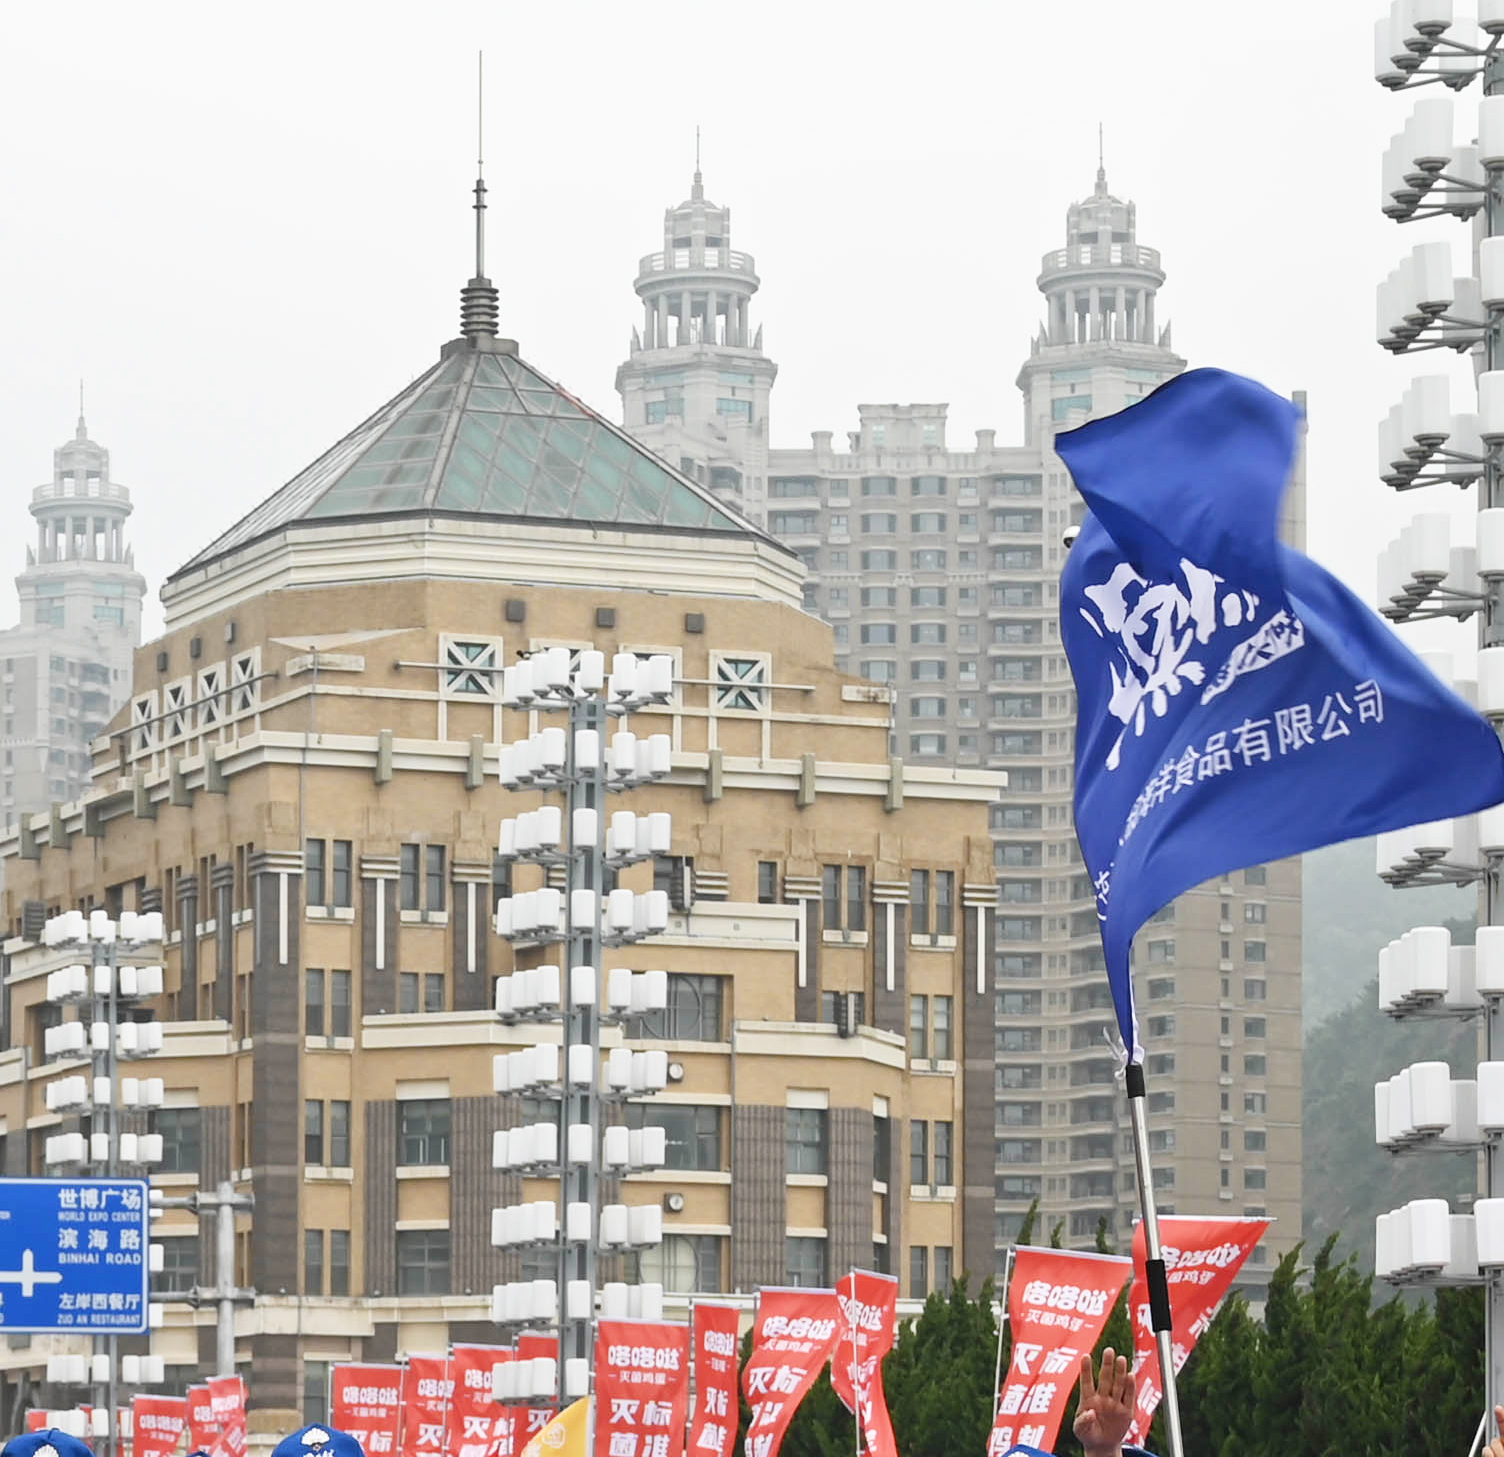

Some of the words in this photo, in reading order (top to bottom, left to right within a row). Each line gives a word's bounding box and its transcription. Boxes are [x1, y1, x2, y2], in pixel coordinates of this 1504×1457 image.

[58, 1188, 141, 1210] 世博广场
[58, 1228, 141, 1250] 滨海路
[58, 1253, 99, 1264] BINHAI
[105, 1253, 141, 1264] ROAD
[58, 1293, 141, 1310] 左岸西餐厅
[1022, 1280, 1109, 1316] 咯咯哒
[1027, 1309, 1086, 1332] 灭菌鸡蛋
[608, 1345, 680, 1370] 咯咯哒
